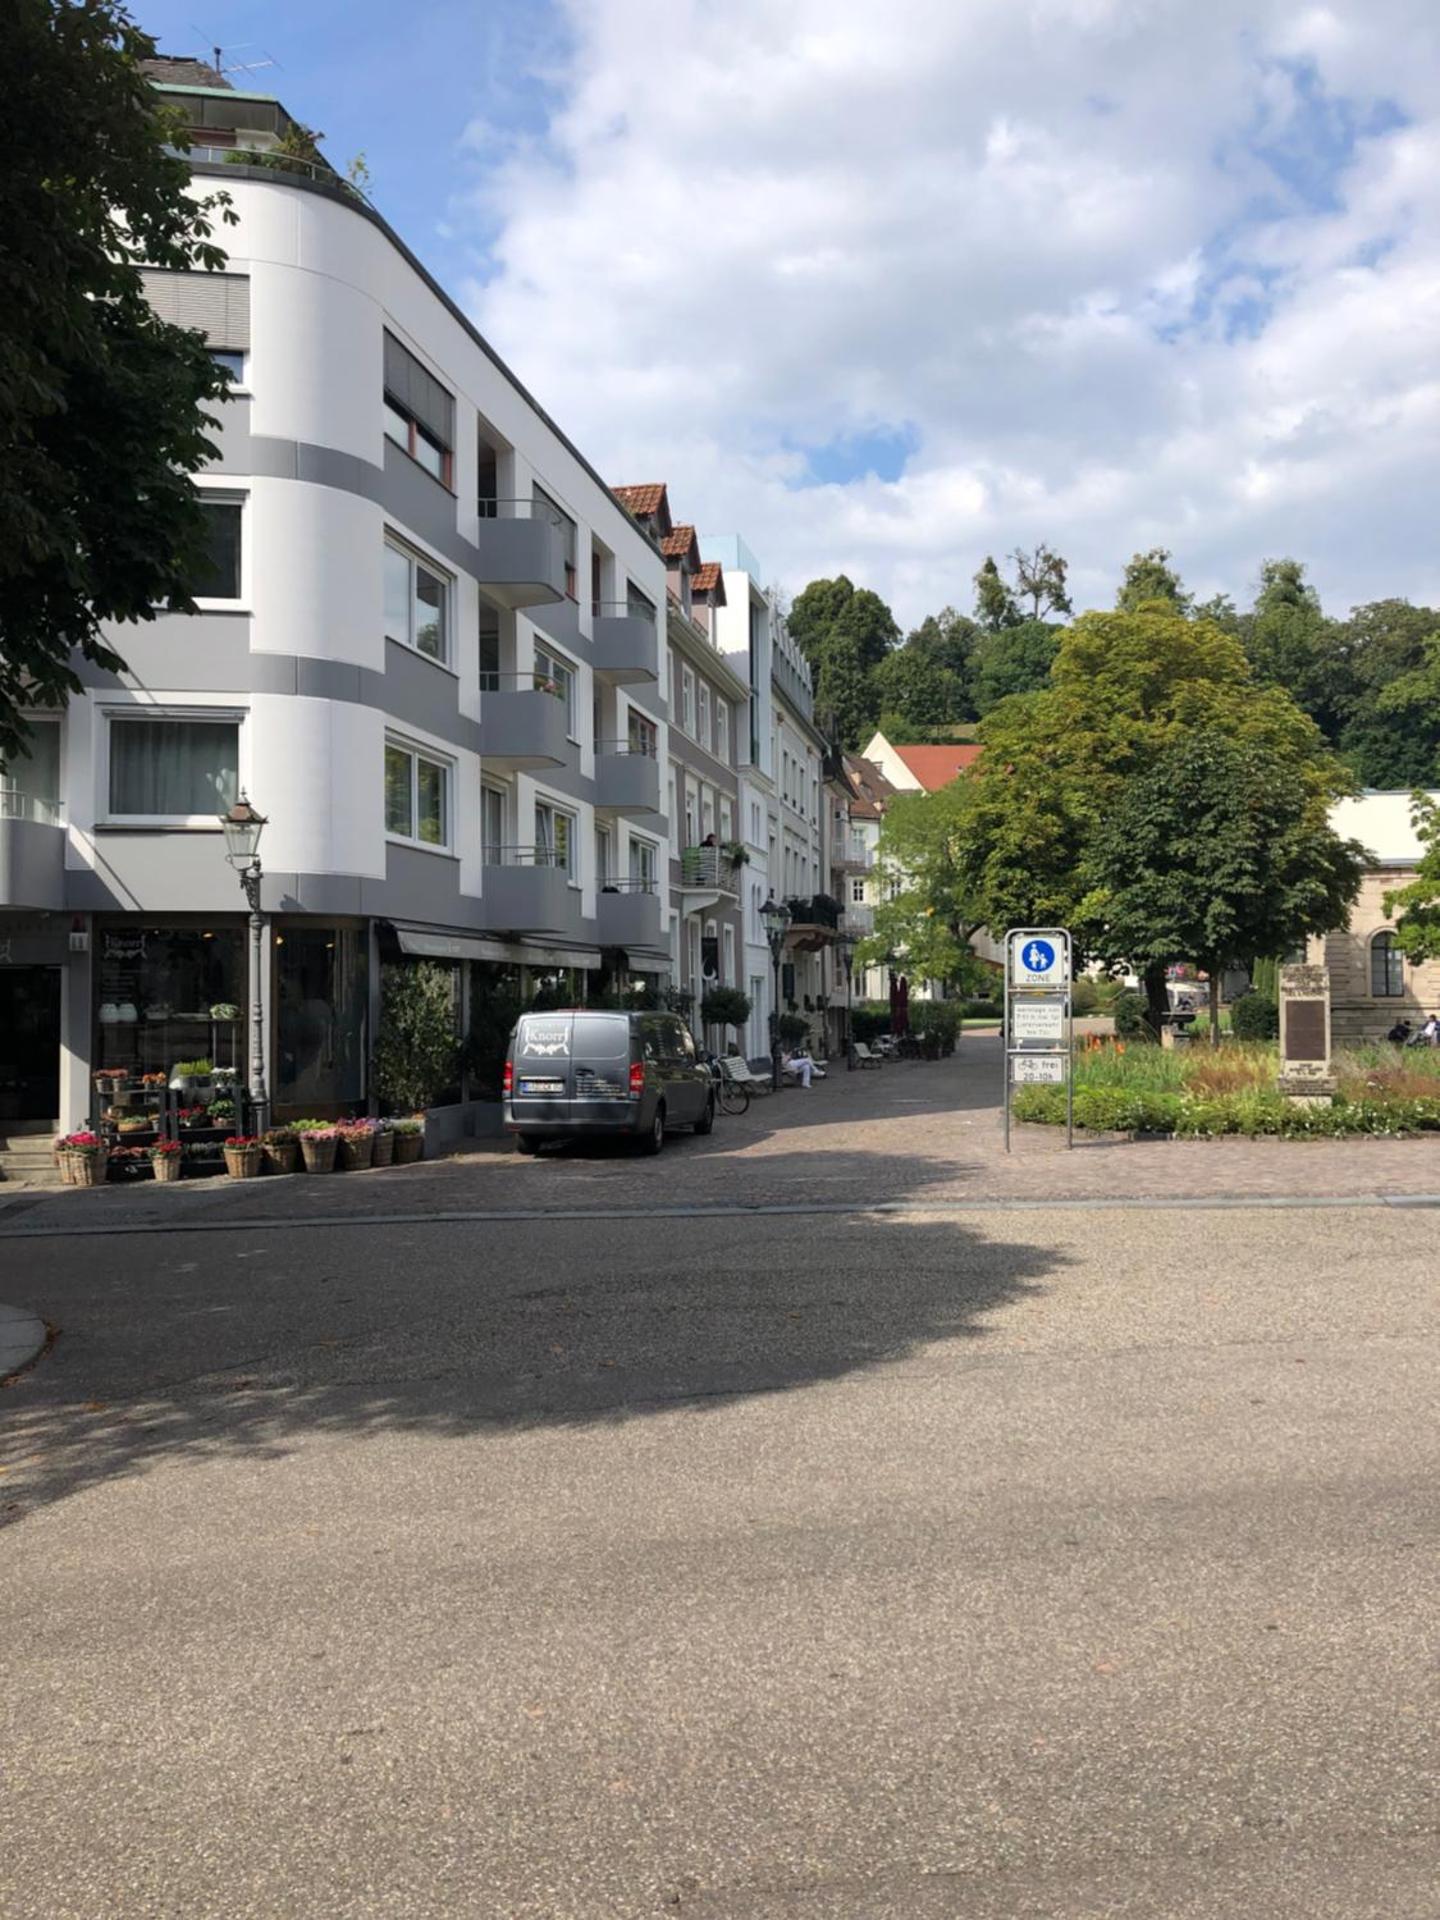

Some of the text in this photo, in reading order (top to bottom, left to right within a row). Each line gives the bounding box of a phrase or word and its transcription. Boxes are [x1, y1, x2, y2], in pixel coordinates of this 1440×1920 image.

[1025, 973, 1051, 982] ZONE
[529, 1029, 565, 1041] Knorr
[1042, 1060, 1058, 1069] frei
